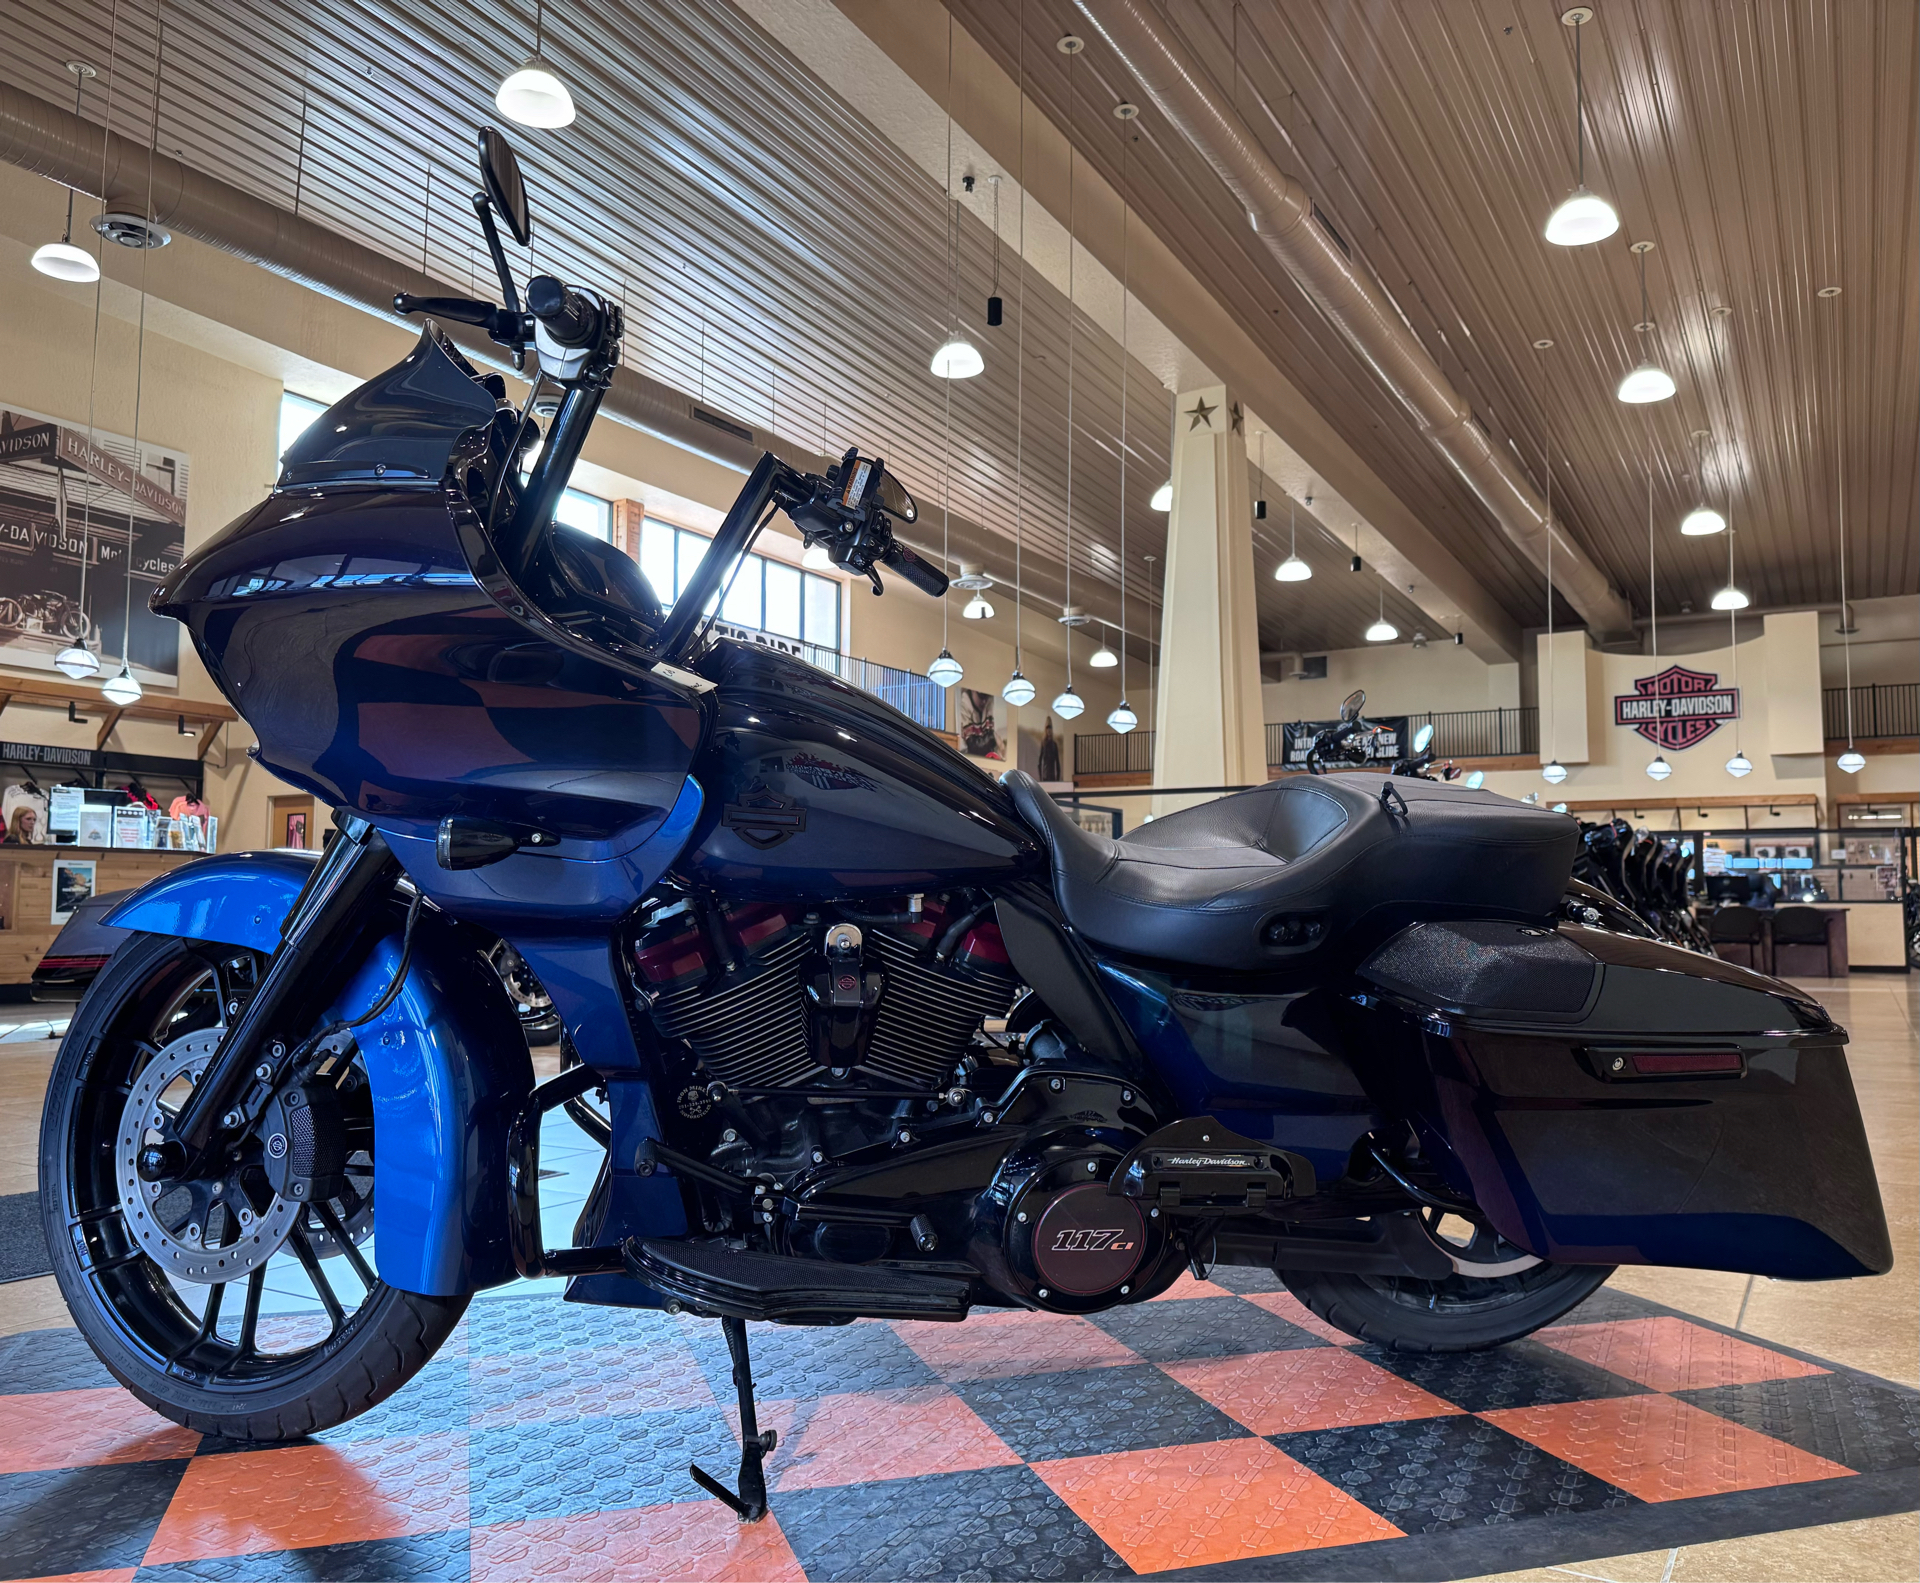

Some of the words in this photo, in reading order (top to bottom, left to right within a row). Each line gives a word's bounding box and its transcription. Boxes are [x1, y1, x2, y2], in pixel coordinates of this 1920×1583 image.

[67, 437, 185, 517] HARLEY-DAVIDSON
[1647, 673, 1706, 695] MOTOR
[1622, 694, 1733, 719] HARLEY-DAVIDSON
[1648, 720, 1707, 744] CYCLES
[2, 743, 91, 766] HARLEY-DAVIDSON
